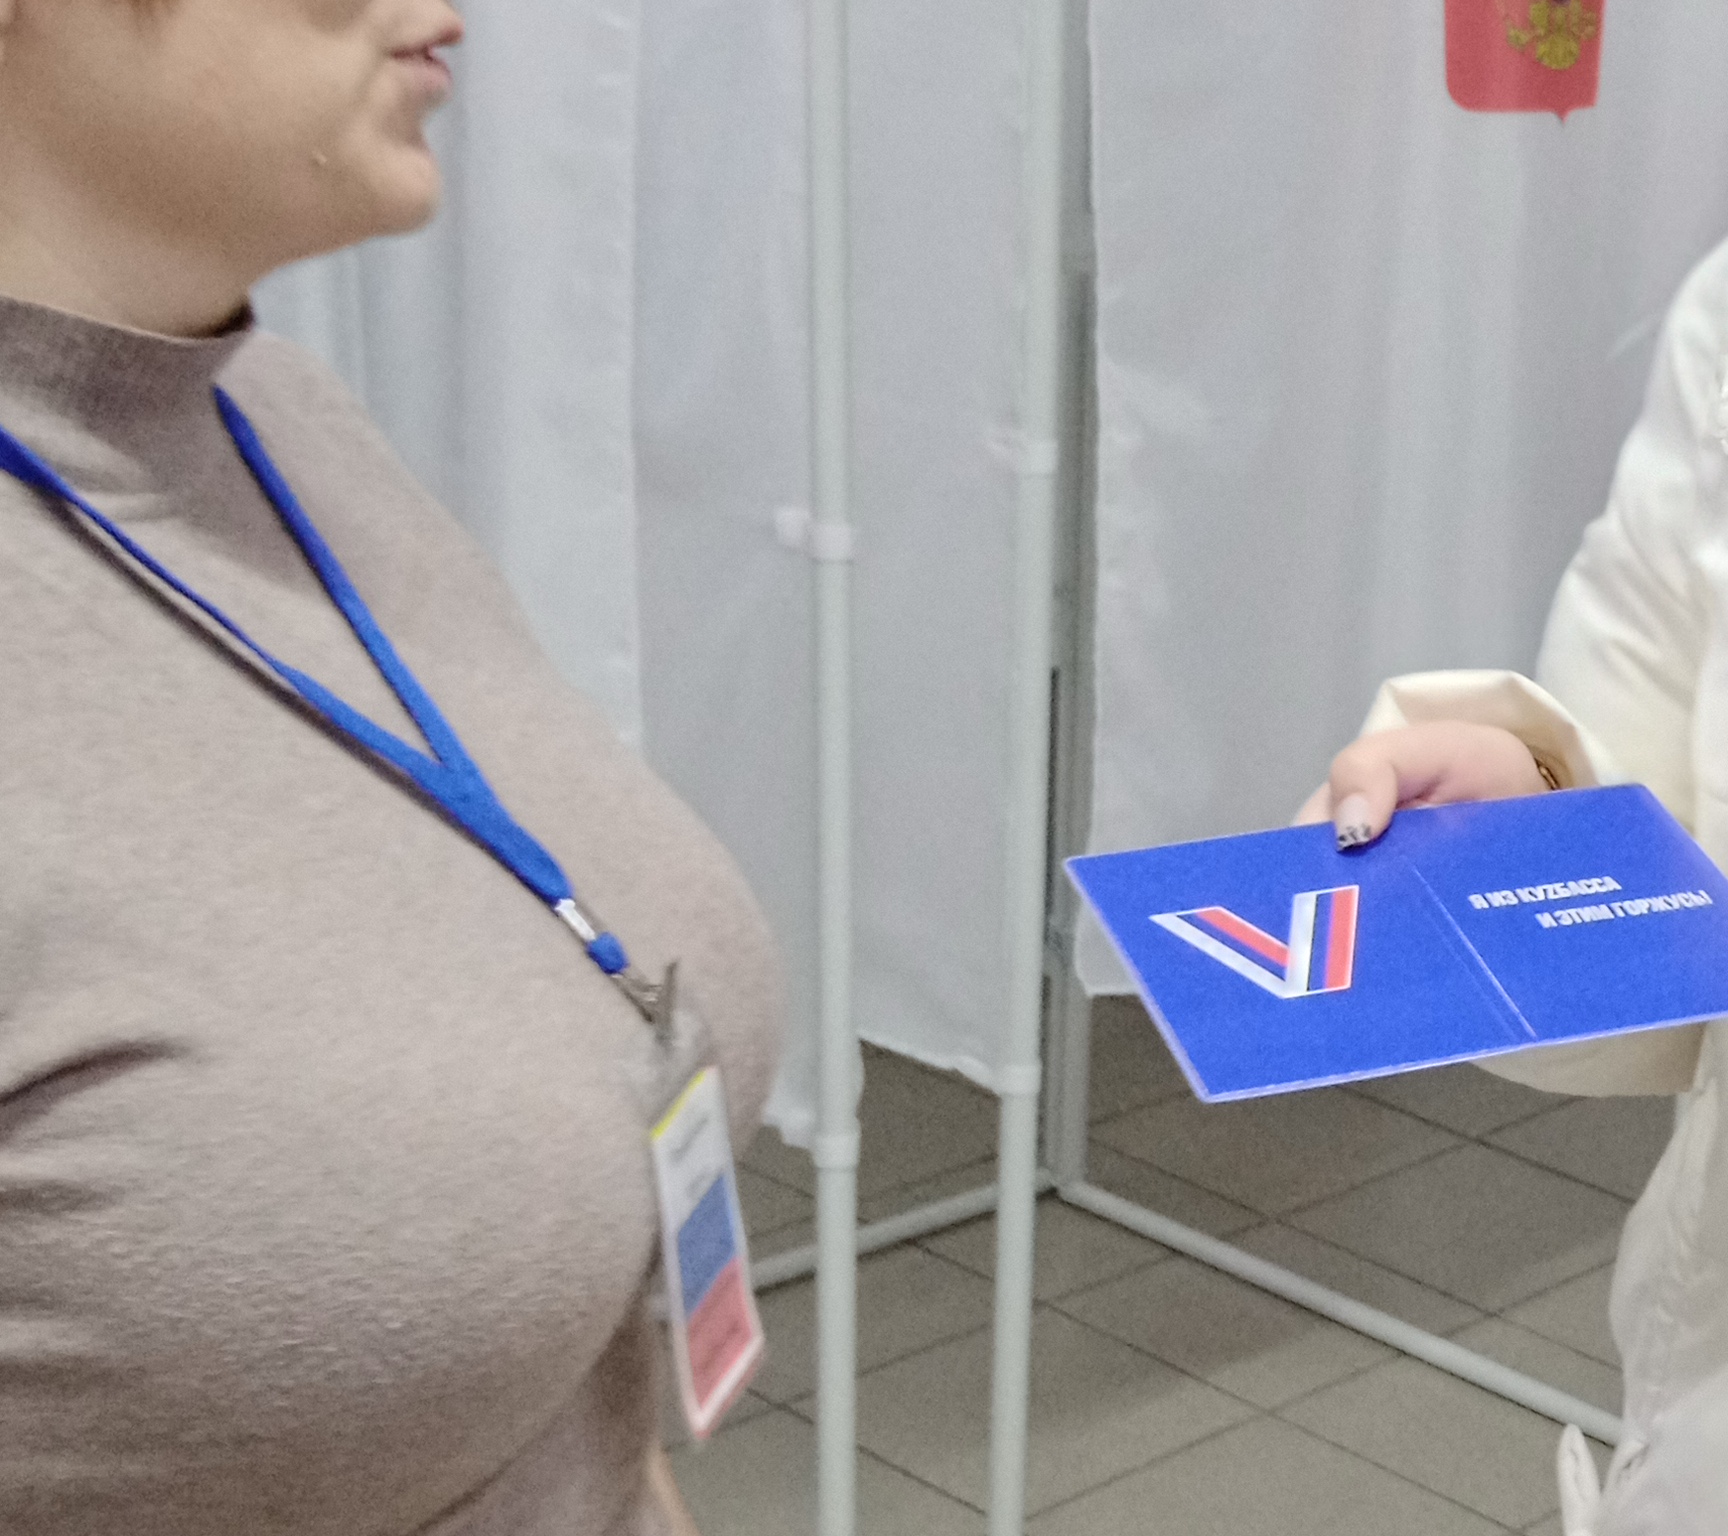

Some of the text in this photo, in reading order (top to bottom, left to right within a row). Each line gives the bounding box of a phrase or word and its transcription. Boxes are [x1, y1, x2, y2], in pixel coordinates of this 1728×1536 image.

[1467, 893, 1491, 910] Я
[1484, 889, 1520, 908] ИЗ
[1534, 889, 1714, 929] И ЭТИМ ГОРЖУСЬ!
